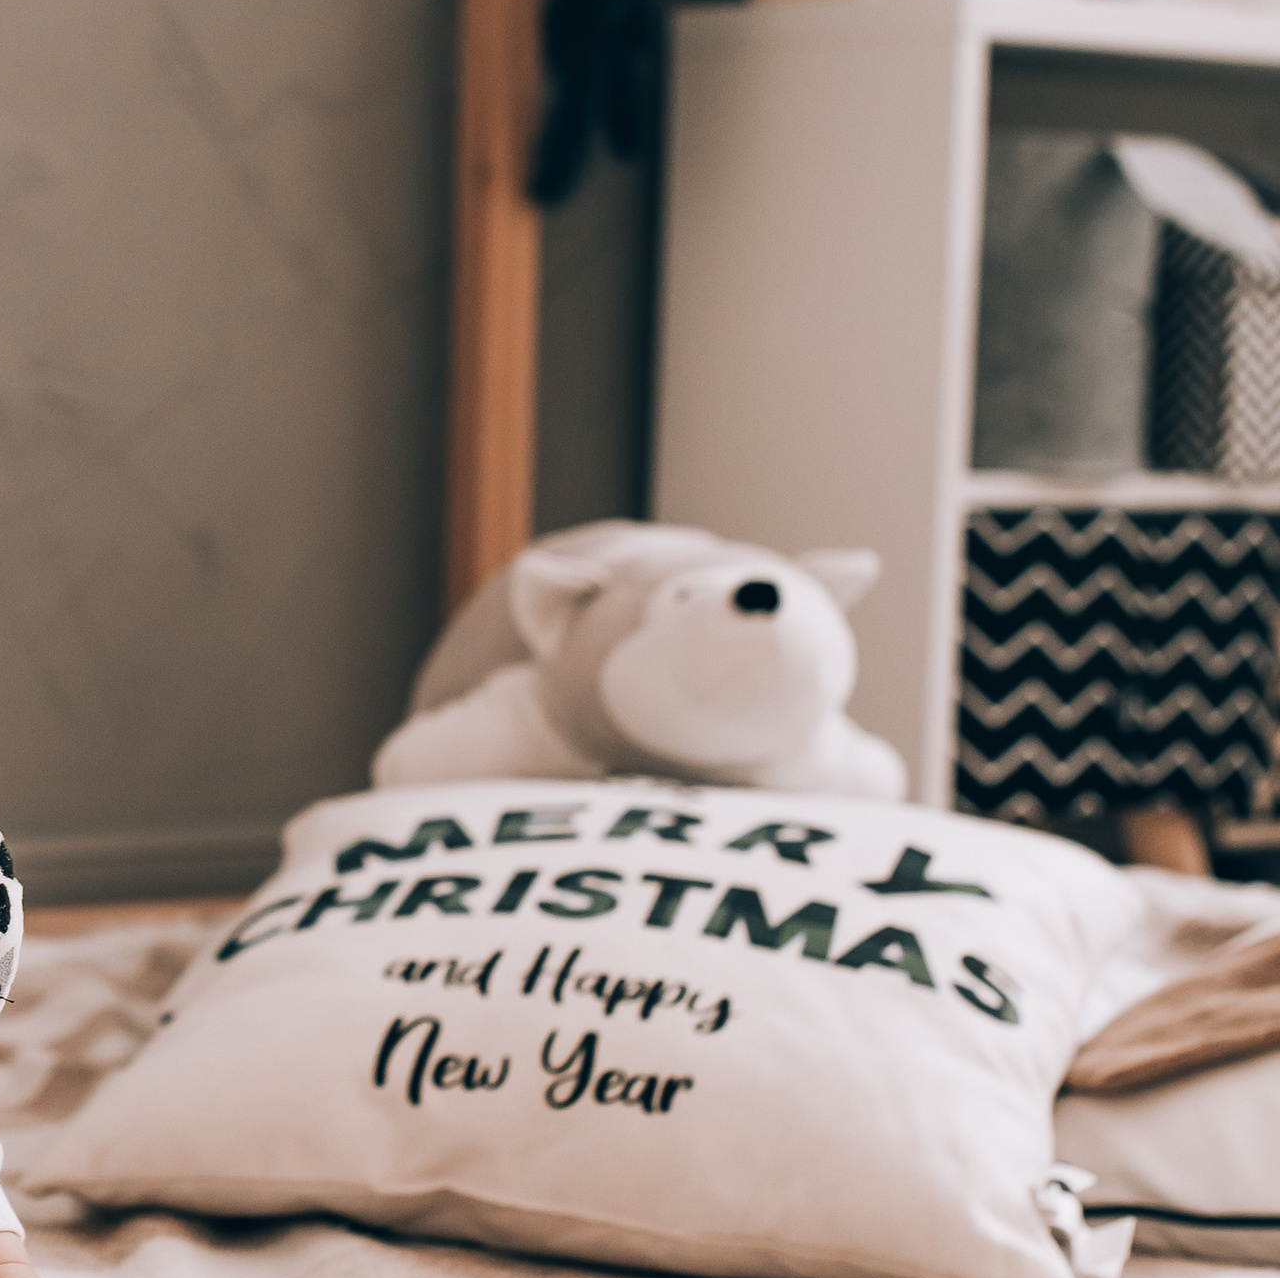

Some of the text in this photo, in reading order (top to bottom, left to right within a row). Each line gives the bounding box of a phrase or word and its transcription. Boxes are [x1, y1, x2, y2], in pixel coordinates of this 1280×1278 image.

[335, 800, 996, 900] MERRY
[216, 867, 1024, 1026] CHRISTMAS
[382, 944, 733, 1034] and Happy
[372, 1015, 696, 1114] New Year
